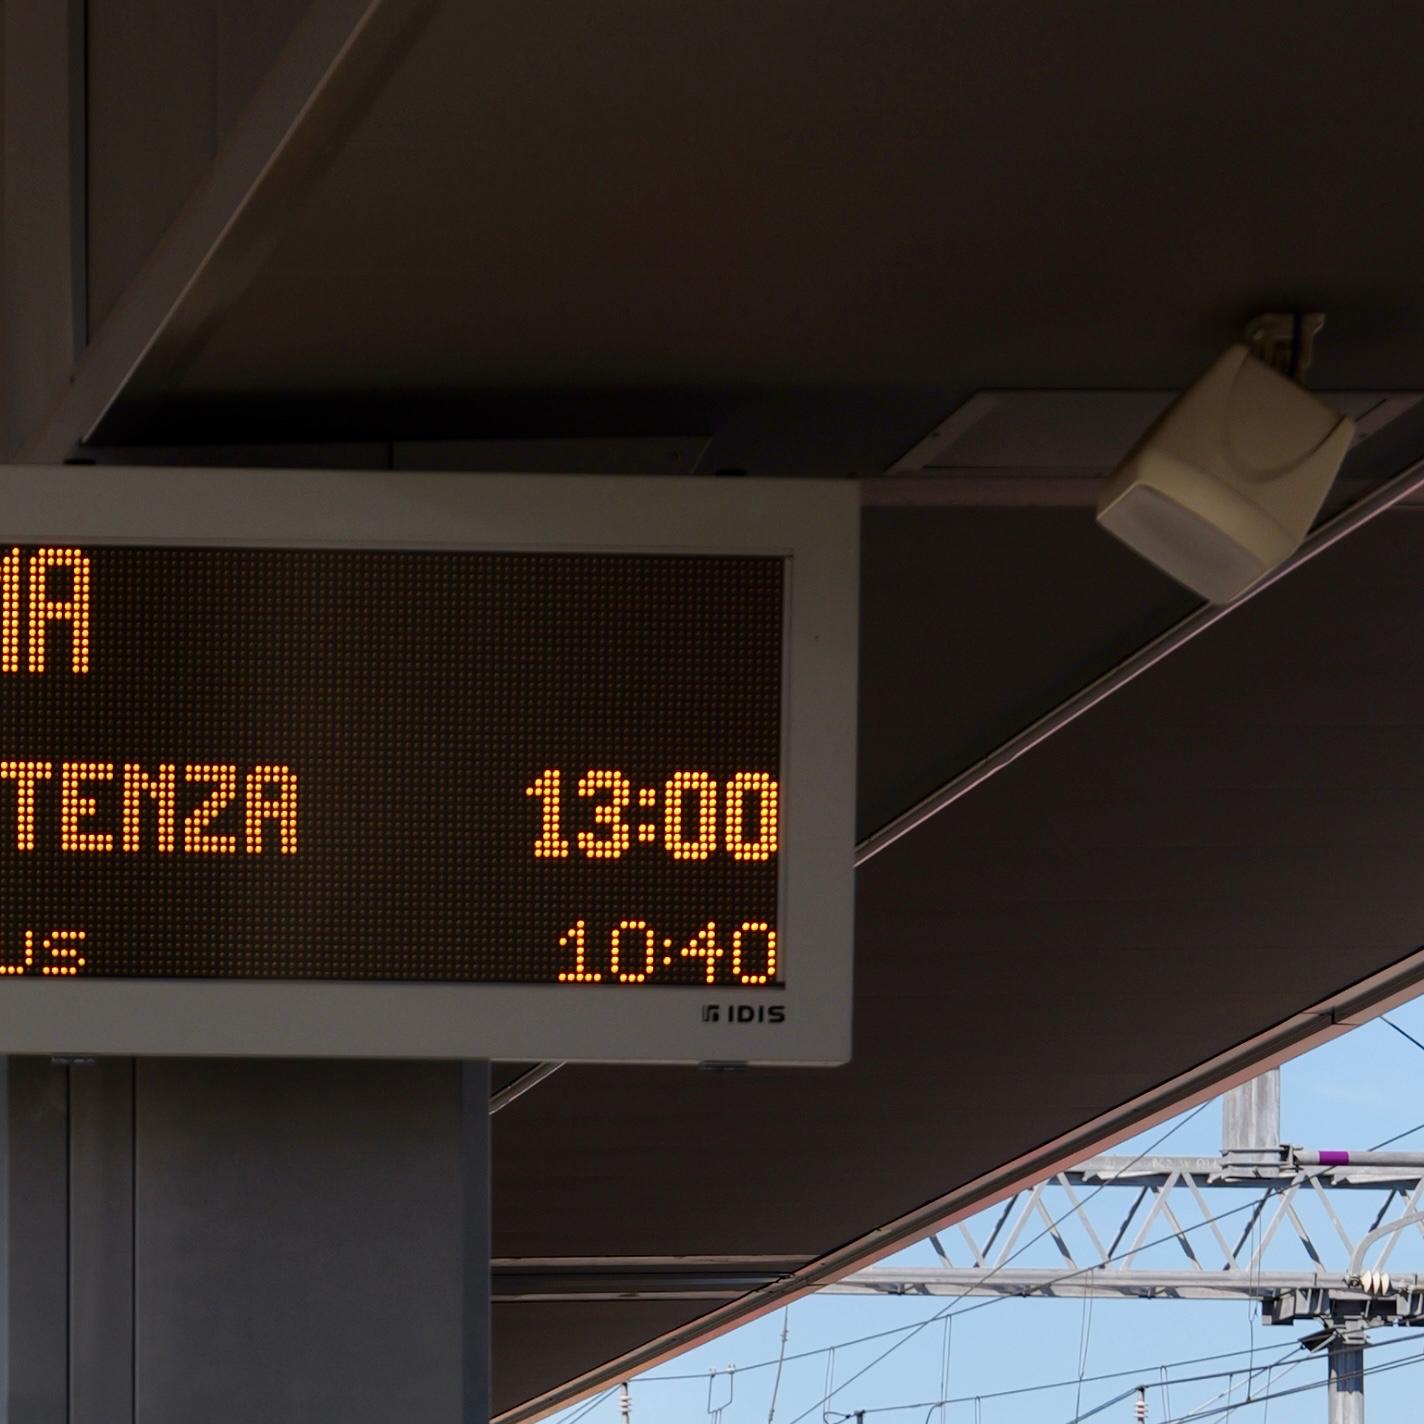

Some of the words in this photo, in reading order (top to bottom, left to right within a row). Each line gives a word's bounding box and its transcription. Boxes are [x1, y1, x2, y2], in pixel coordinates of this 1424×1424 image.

[525, 769, 779, 861] 13:00
[558, 920, 776, 984] 10:40
[728, 1005, 786, 1023] IDIS
